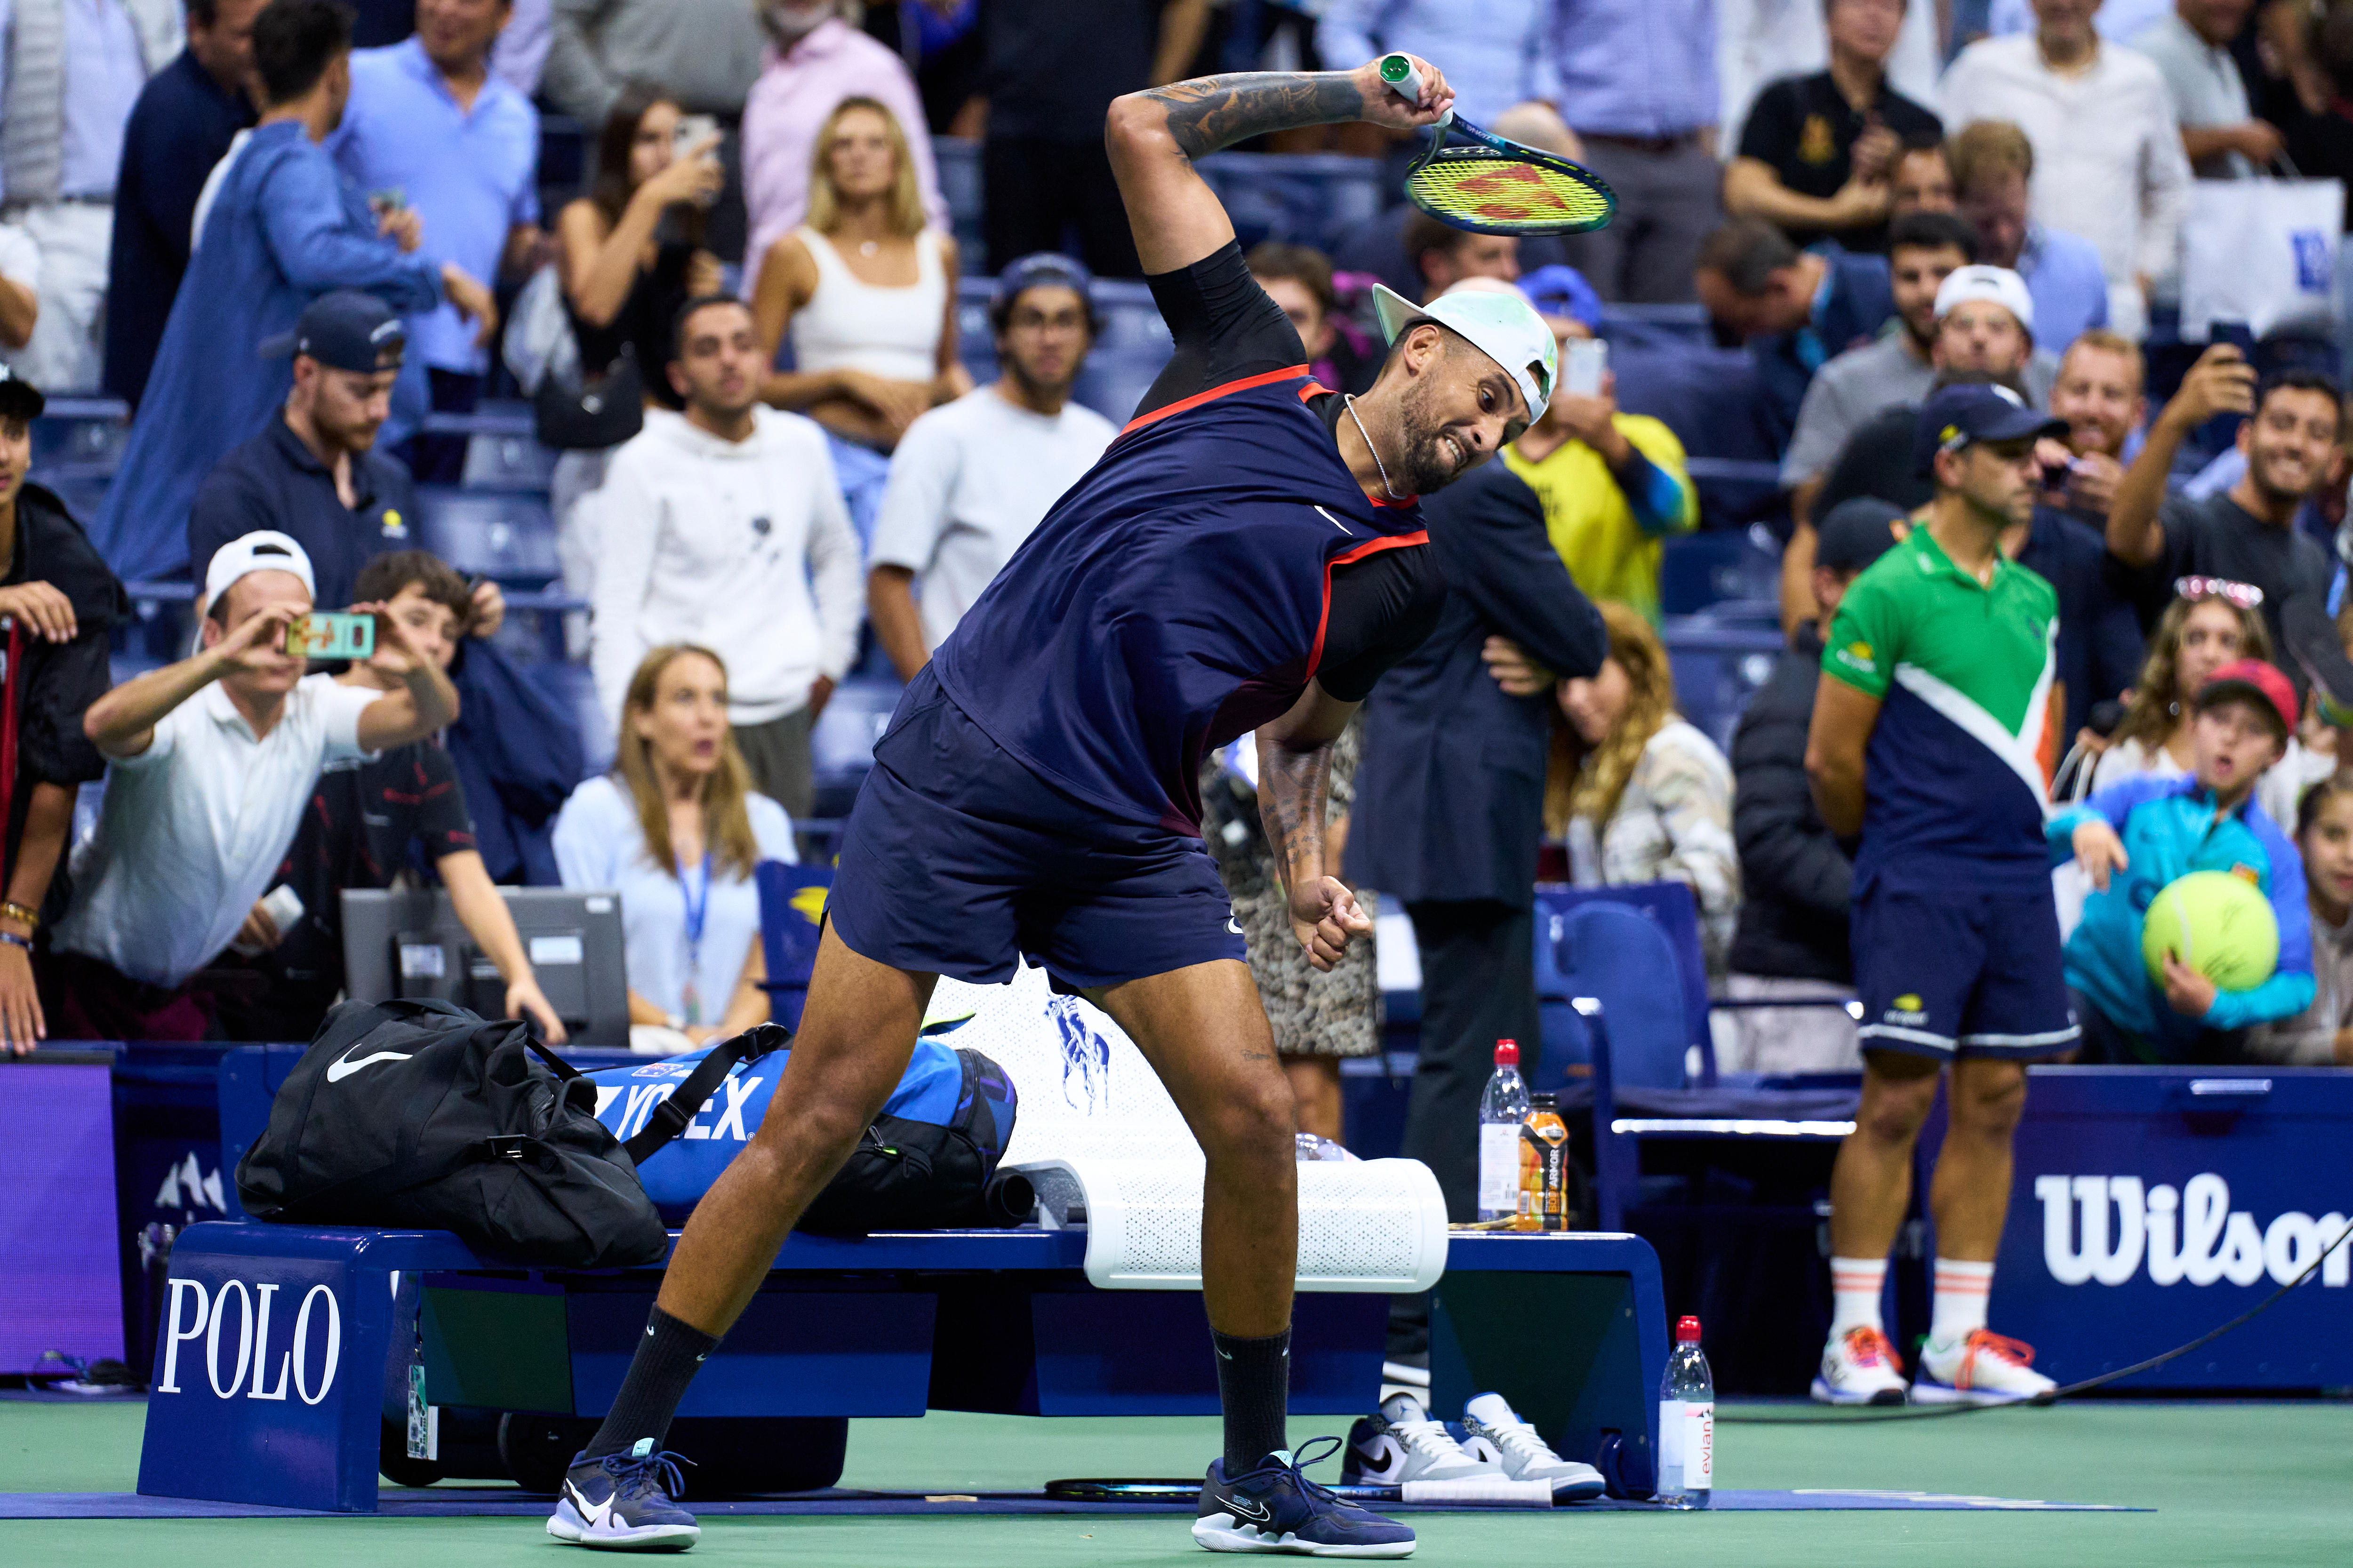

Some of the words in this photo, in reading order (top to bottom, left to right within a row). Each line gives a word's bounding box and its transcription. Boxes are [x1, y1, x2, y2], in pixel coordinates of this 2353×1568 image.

[614, 1077, 763, 1142] YOEX
[158, 1278, 340, 1405] POLO
[1700, 1421, 1711, 1474] evian
